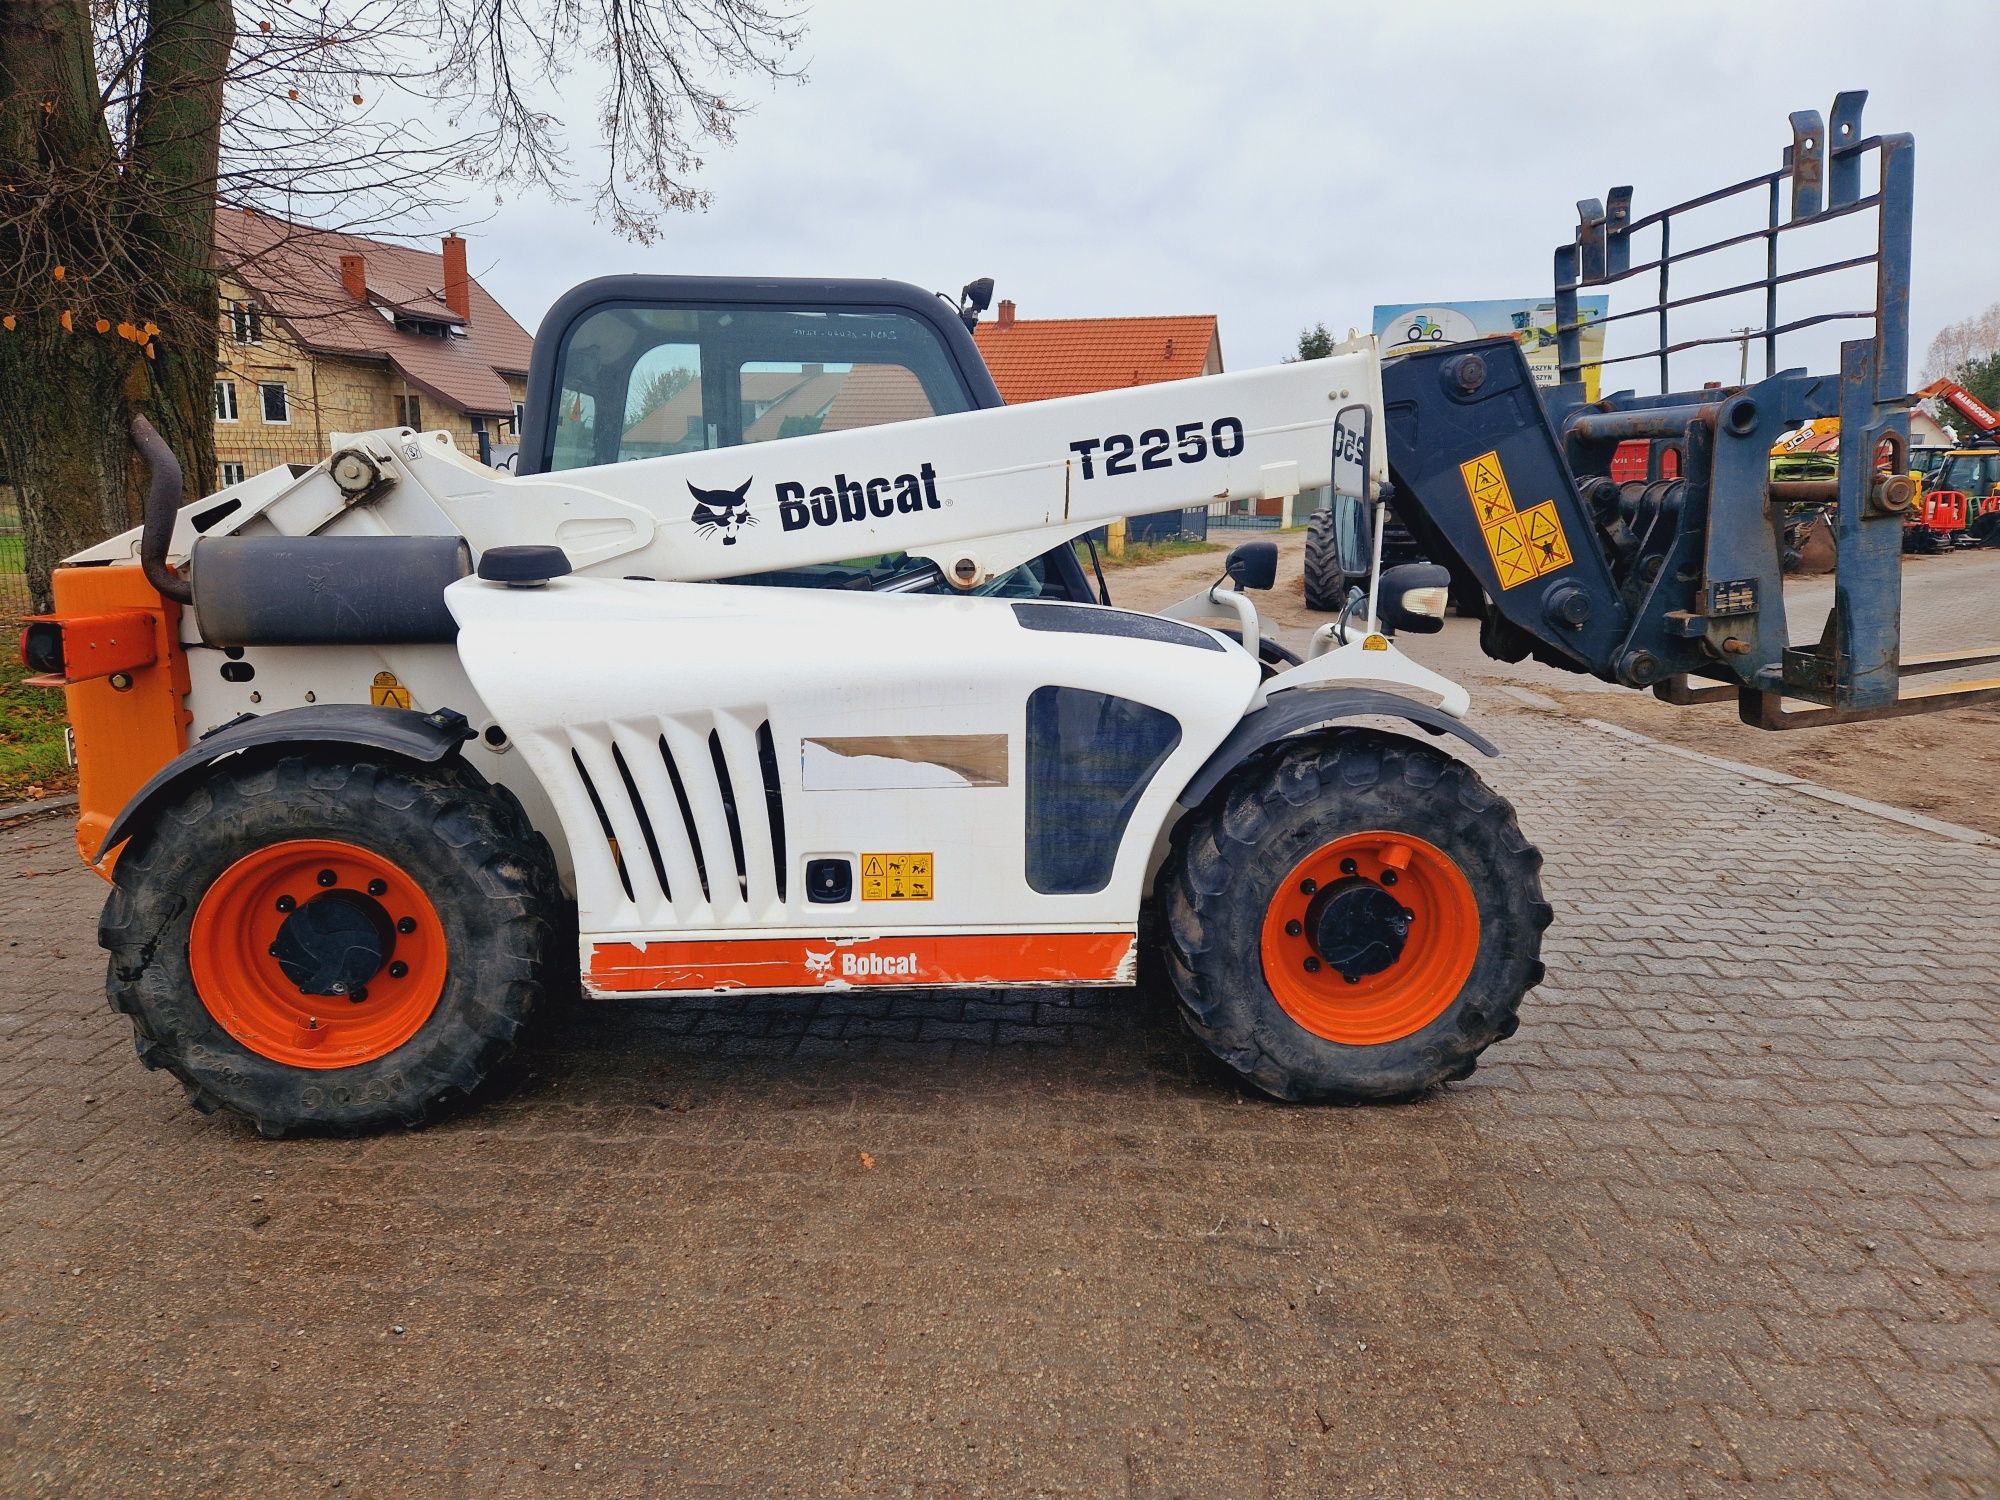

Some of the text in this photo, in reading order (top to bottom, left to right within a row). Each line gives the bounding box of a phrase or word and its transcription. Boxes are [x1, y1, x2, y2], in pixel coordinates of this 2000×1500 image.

[1955, 391, 1996, 425] MANISCOPIC
[1069, 416, 1245, 480] T2250
[1784, 428, 1815, 451] JCB
[775, 462, 942, 532] Bobcat
[842, 952, 918, 976] Bobcat
